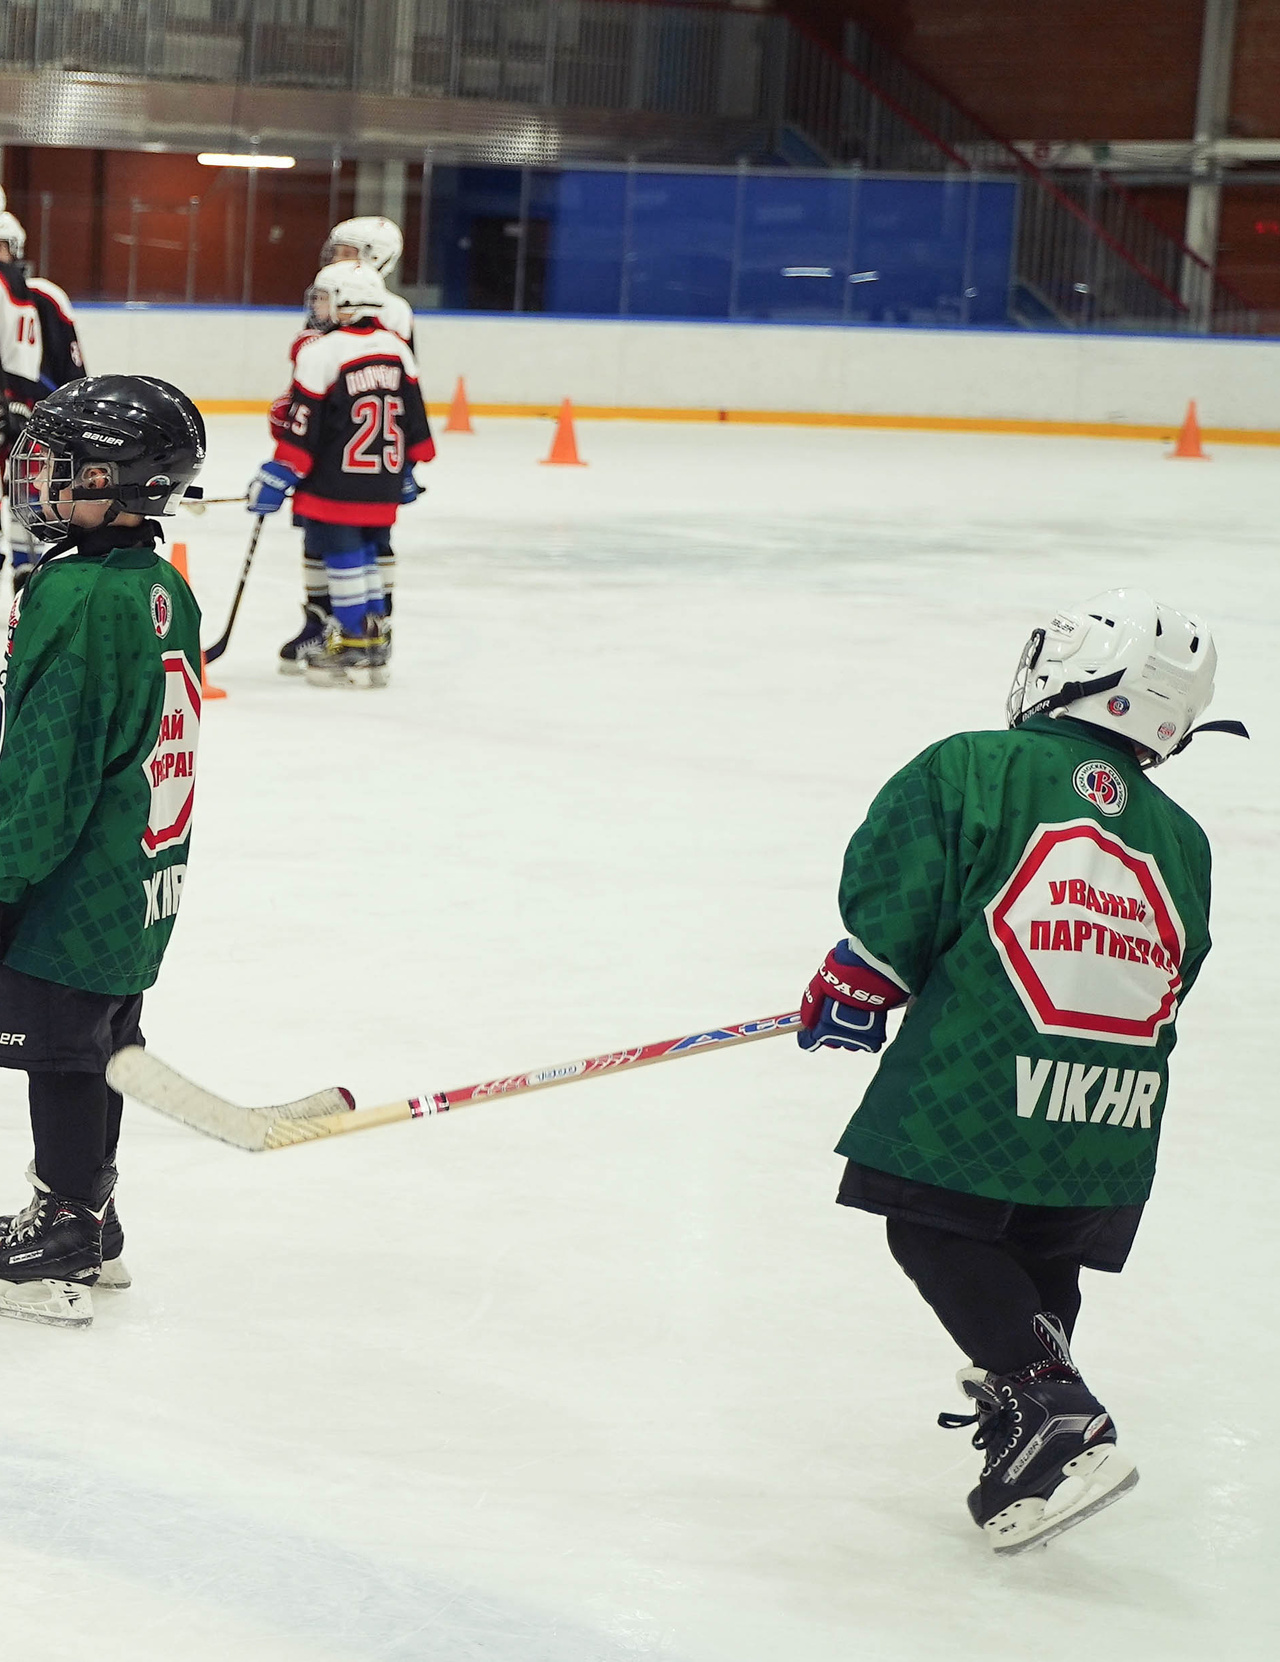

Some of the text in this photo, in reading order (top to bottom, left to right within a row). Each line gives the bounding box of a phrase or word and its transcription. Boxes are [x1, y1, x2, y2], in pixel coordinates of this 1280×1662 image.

[81, 430, 125, 447] BAUER
[341, 394, 405, 474] 25
[1016, 1055, 1161, 1130] VIKHR
